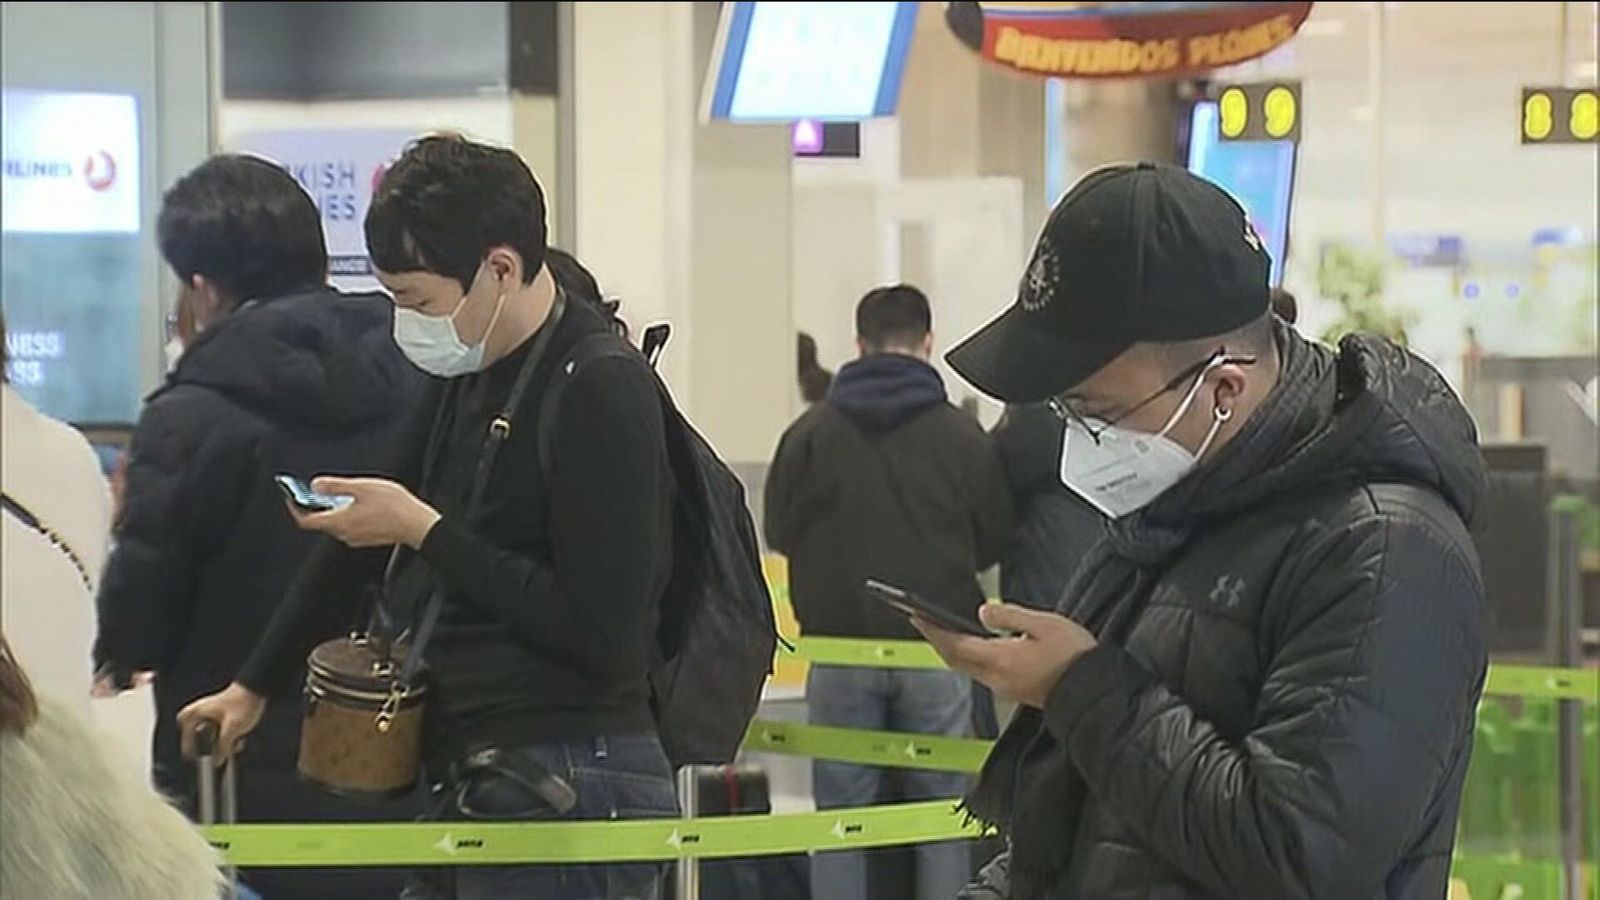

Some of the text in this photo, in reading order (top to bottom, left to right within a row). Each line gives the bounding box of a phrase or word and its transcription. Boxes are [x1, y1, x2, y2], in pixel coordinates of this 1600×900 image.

[994, 26, 1180, 74] BIENVENIDOS
[1220, 87, 1296, 138] 9 9
[1525, 92, 1599, 140] 8 8
